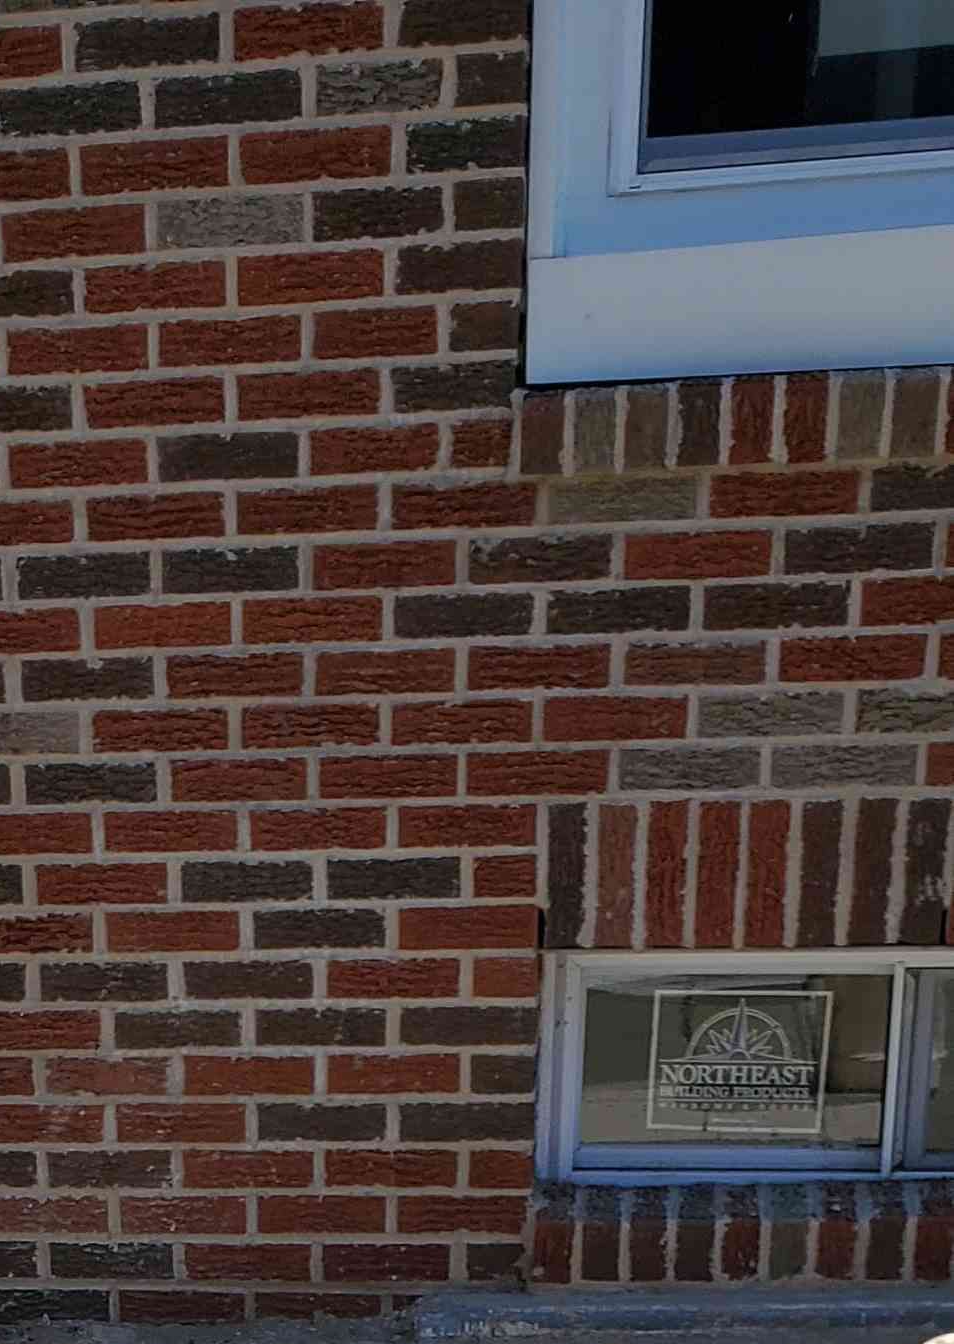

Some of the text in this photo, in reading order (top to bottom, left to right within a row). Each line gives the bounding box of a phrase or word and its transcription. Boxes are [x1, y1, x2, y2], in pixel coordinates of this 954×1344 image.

[659, 1064, 815, 1085] NORTHEAST
[659, 1086, 810, 1099] BUILDING PRODUCTS
